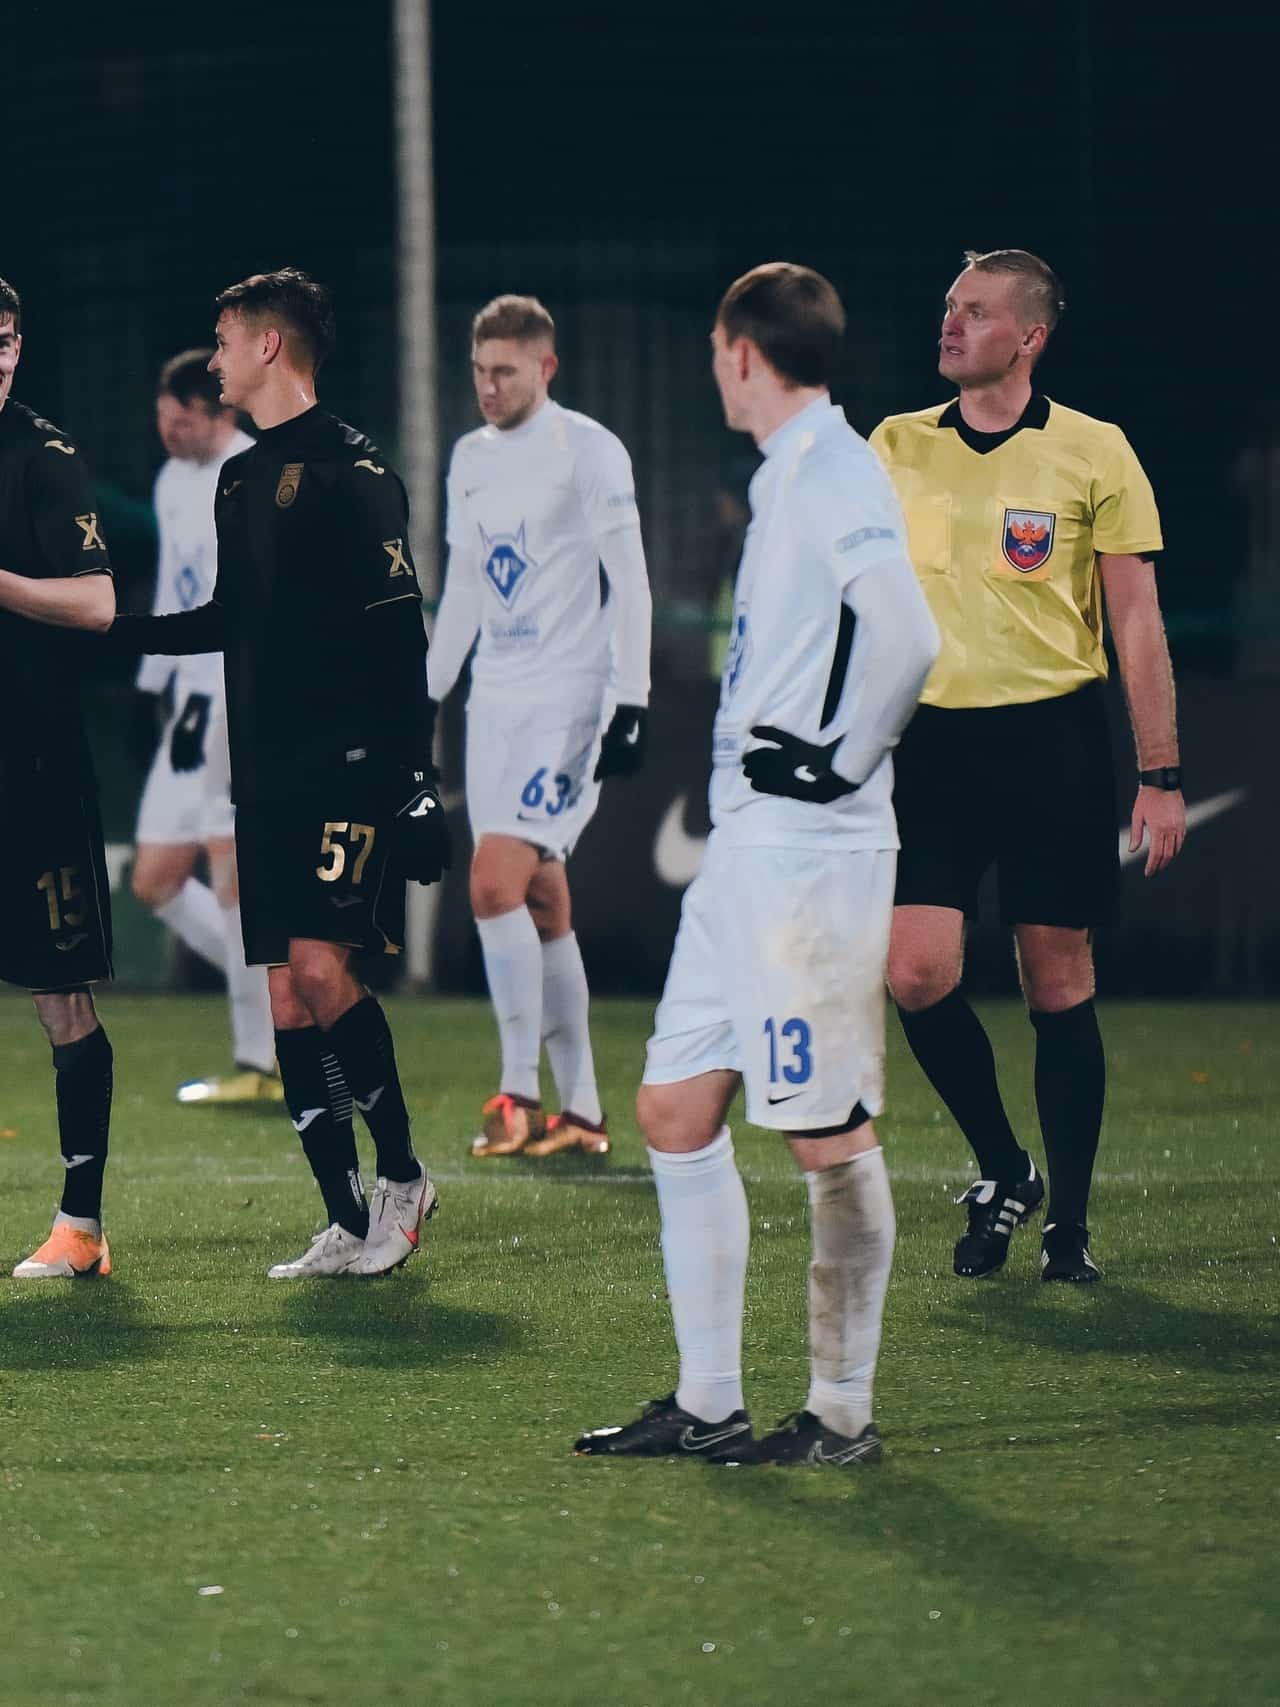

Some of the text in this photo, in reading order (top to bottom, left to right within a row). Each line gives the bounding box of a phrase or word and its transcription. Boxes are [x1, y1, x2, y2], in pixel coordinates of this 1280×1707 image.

[521, 765, 577, 817] 63
[315, 821, 376, 885] 57
[35, 866, 86, 929] 15
[764, 1016, 811, 1084] 13
